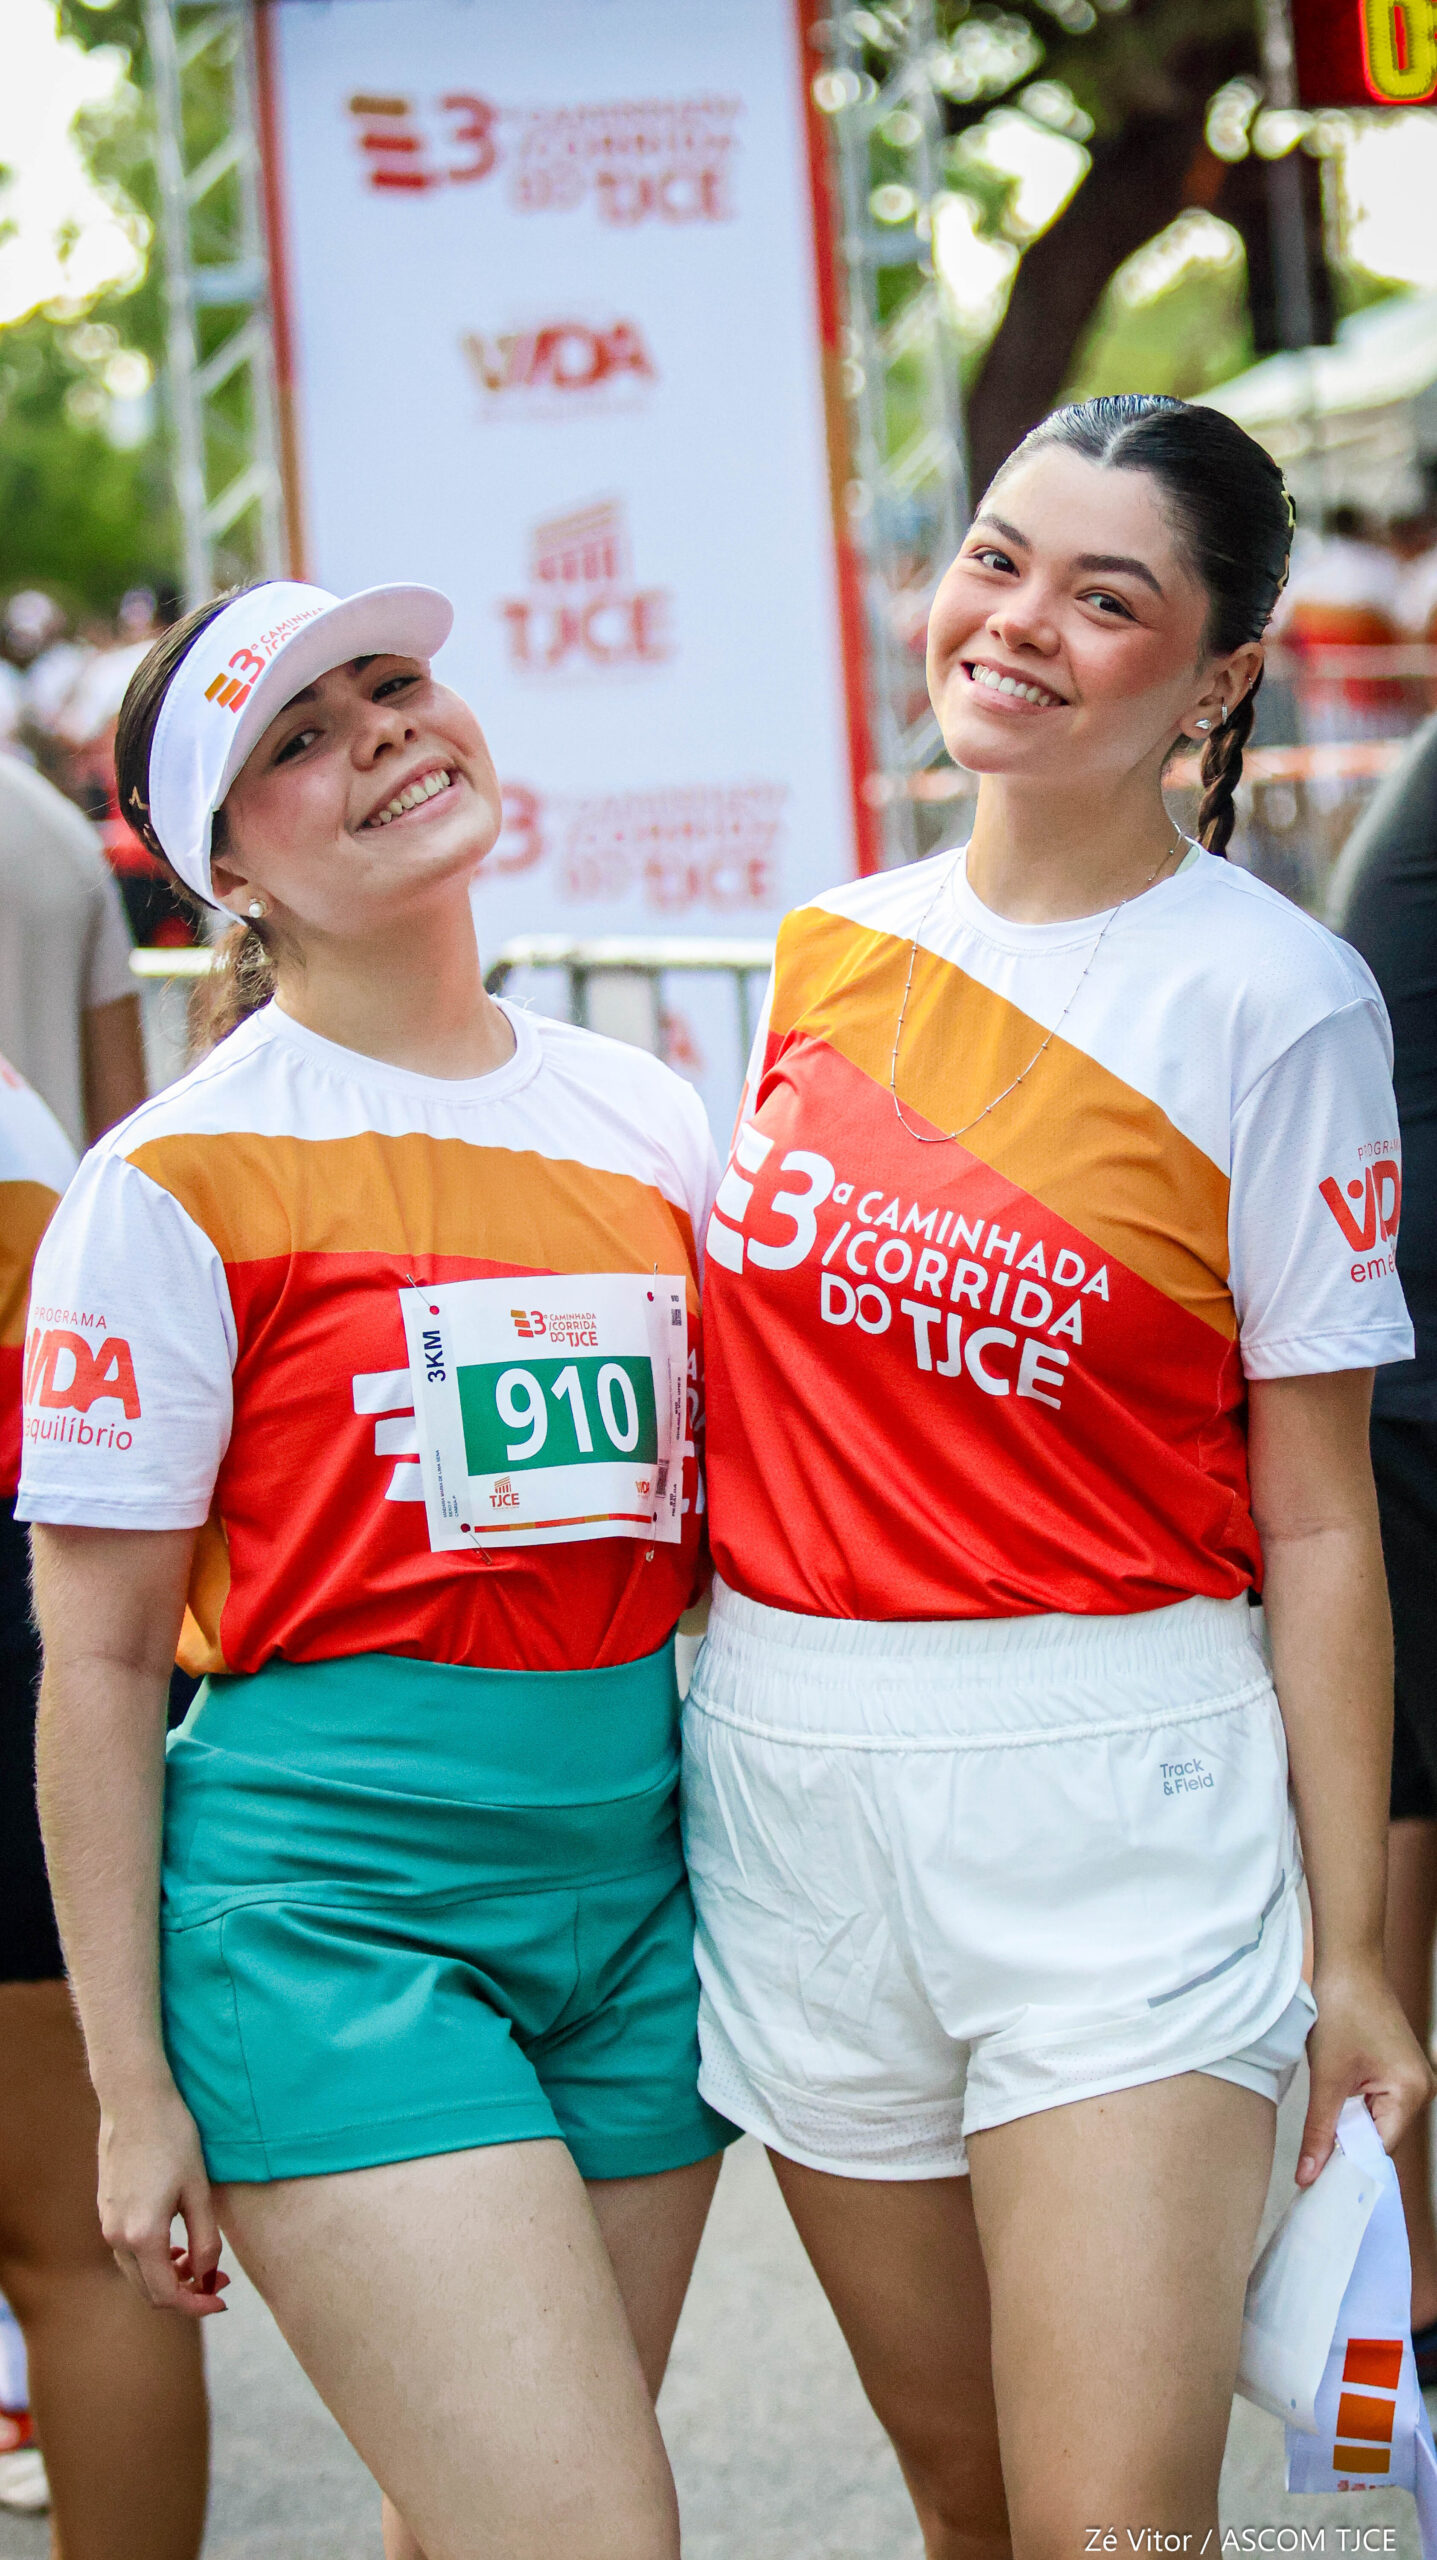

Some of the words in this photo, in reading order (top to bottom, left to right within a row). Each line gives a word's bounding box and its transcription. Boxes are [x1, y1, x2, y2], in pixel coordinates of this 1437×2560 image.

[260, 607, 325, 644] CAMINHA
[1319, 1160, 1401, 1252] VID
[856, 1190, 1111, 1302] CAMINHADA
[33, 1306, 108, 1330] PROGRAMA
[549, 1312, 597, 1322] CAMINHADA
[422, 1330, 447, 1383] 3KM
[550, 1331, 566, 1343] DO
[566, 1331, 599, 1348] TJCE
[819, 1271, 892, 1335] DO
[900, 1298, 1070, 1411] TJCE
[495, 1362, 640, 1462] 910
[489, 1492, 520, 1508] TJCE
[1160, 1758, 1204, 1778] Track
